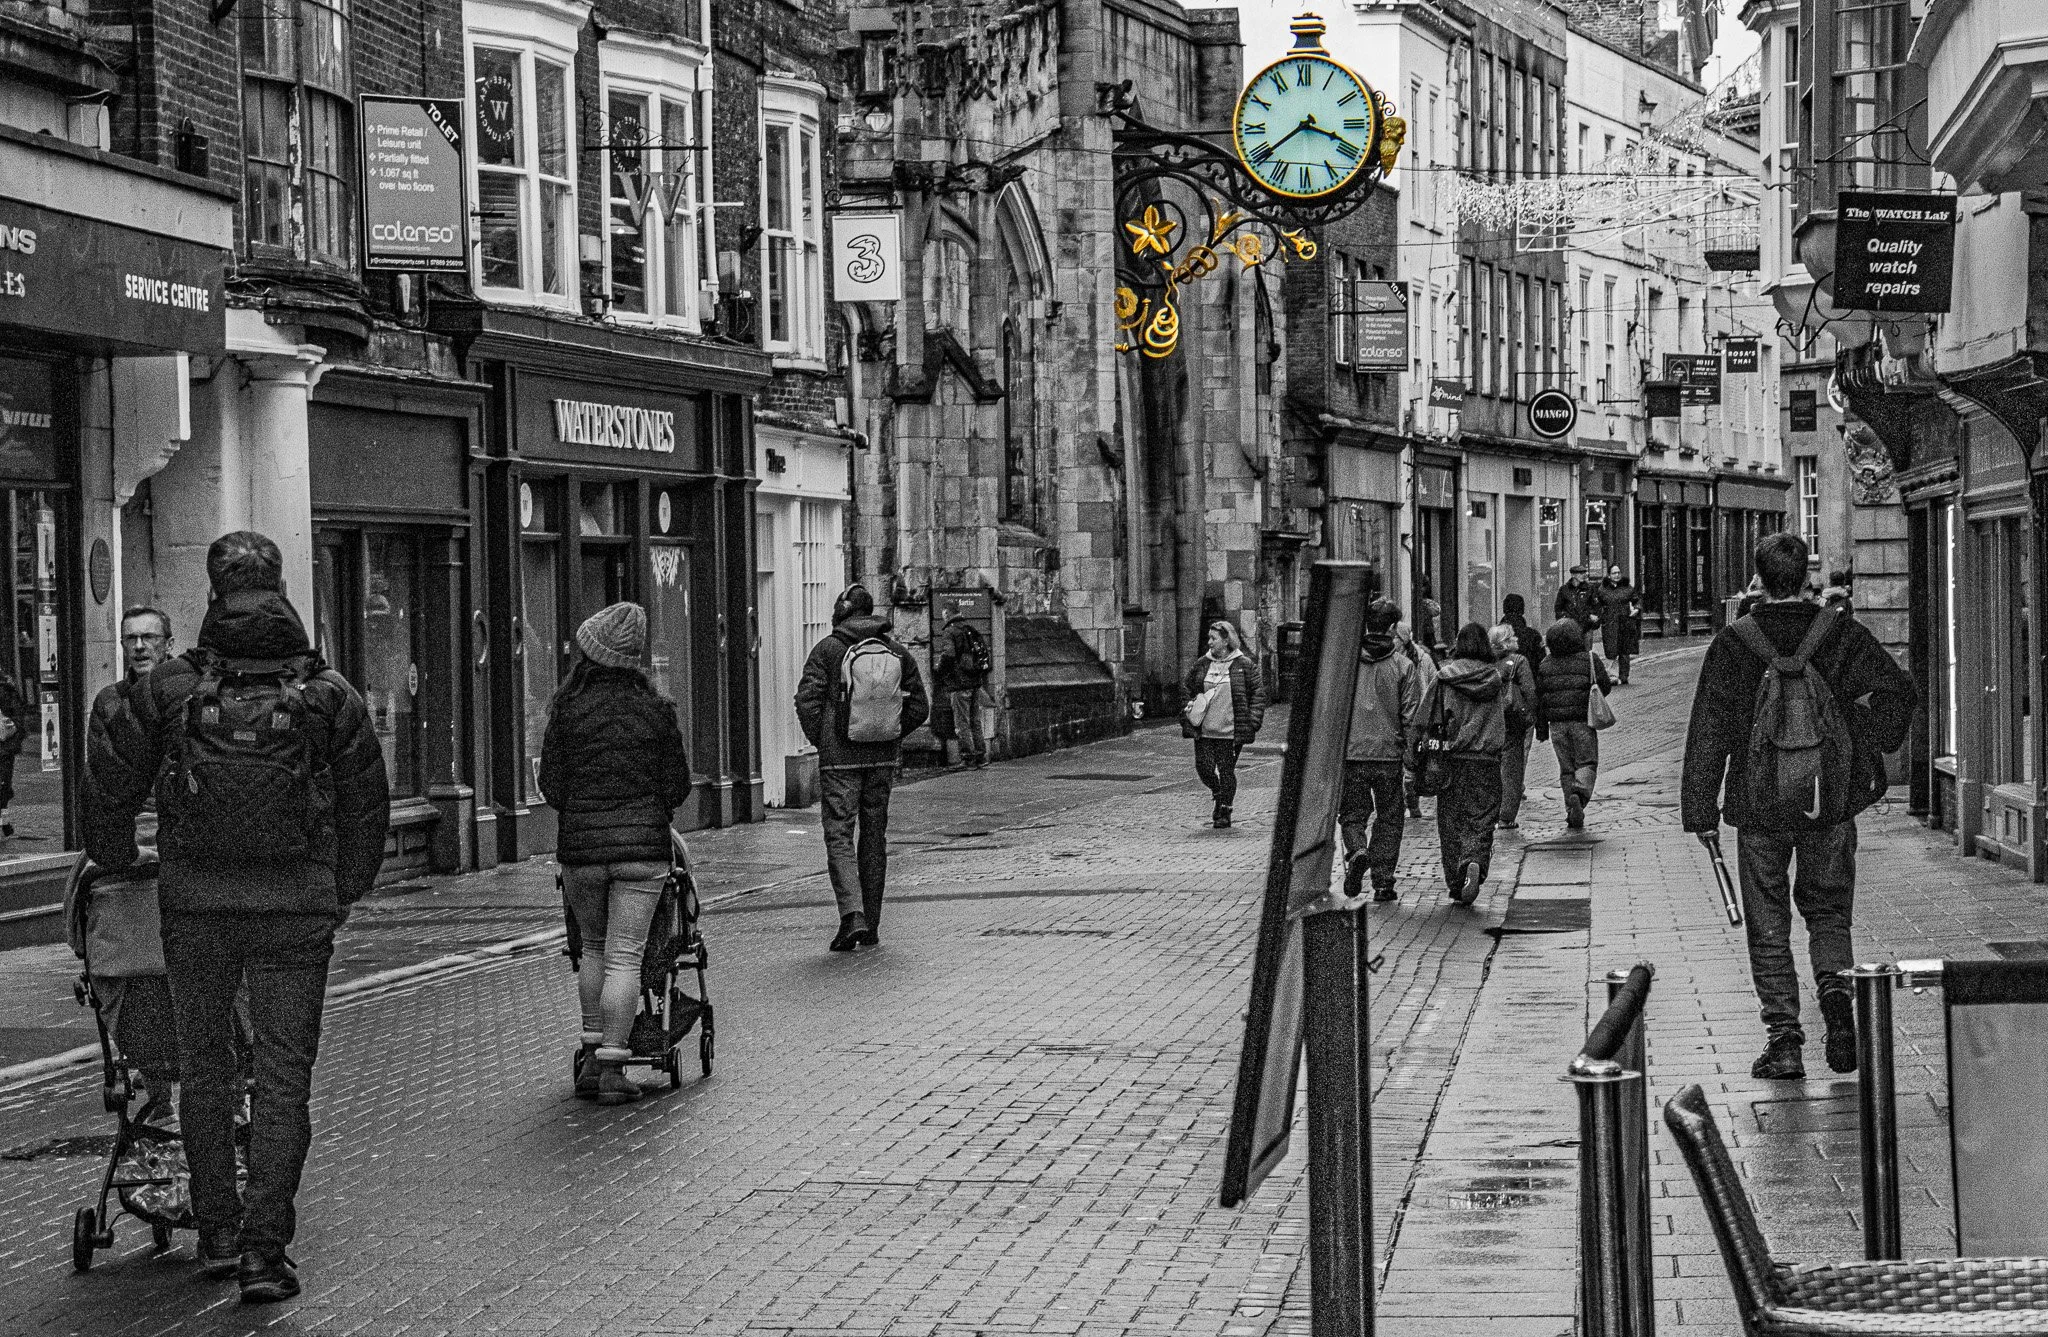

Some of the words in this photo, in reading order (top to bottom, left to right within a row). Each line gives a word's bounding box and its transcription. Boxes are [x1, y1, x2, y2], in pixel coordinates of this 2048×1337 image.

[377, 124, 400, 136] Prime
[401, 126, 423, 137] Retail
[427, 103, 441, 122] TO
[439, 119, 459, 143] LET
[377, 137, 406, 148] Leisure
[407, 139, 421, 150] unit
[378, 152, 409, 165] Partially
[398, 181, 412, 191] two
[413, 181, 435, 192] floors
[613, 172, 693, 227] W
[1846, 207, 1870, 218] The
[1875, 209, 1922, 220] WATCH
[1924, 211, 1950, 221] Lab
[372, 220, 453, 243] colenso
[1867, 238, 1923, 257] Quality
[847, 234, 885, 284] 3
[1869, 260, 1918, 275] watch
[125, 273, 169, 305] SERVICE
[171, 283, 209, 312] CENTRE
[1390, 282, 1399, 293] TO
[1396, 290, 1407, 304] LET
[1865, 280, 1921, 297] repairs
[1359, 345, 1403, 358] colenso
[1536, 409, 1569, 419] MANGO
[554, 398, 675, 454] WATERSTONES
